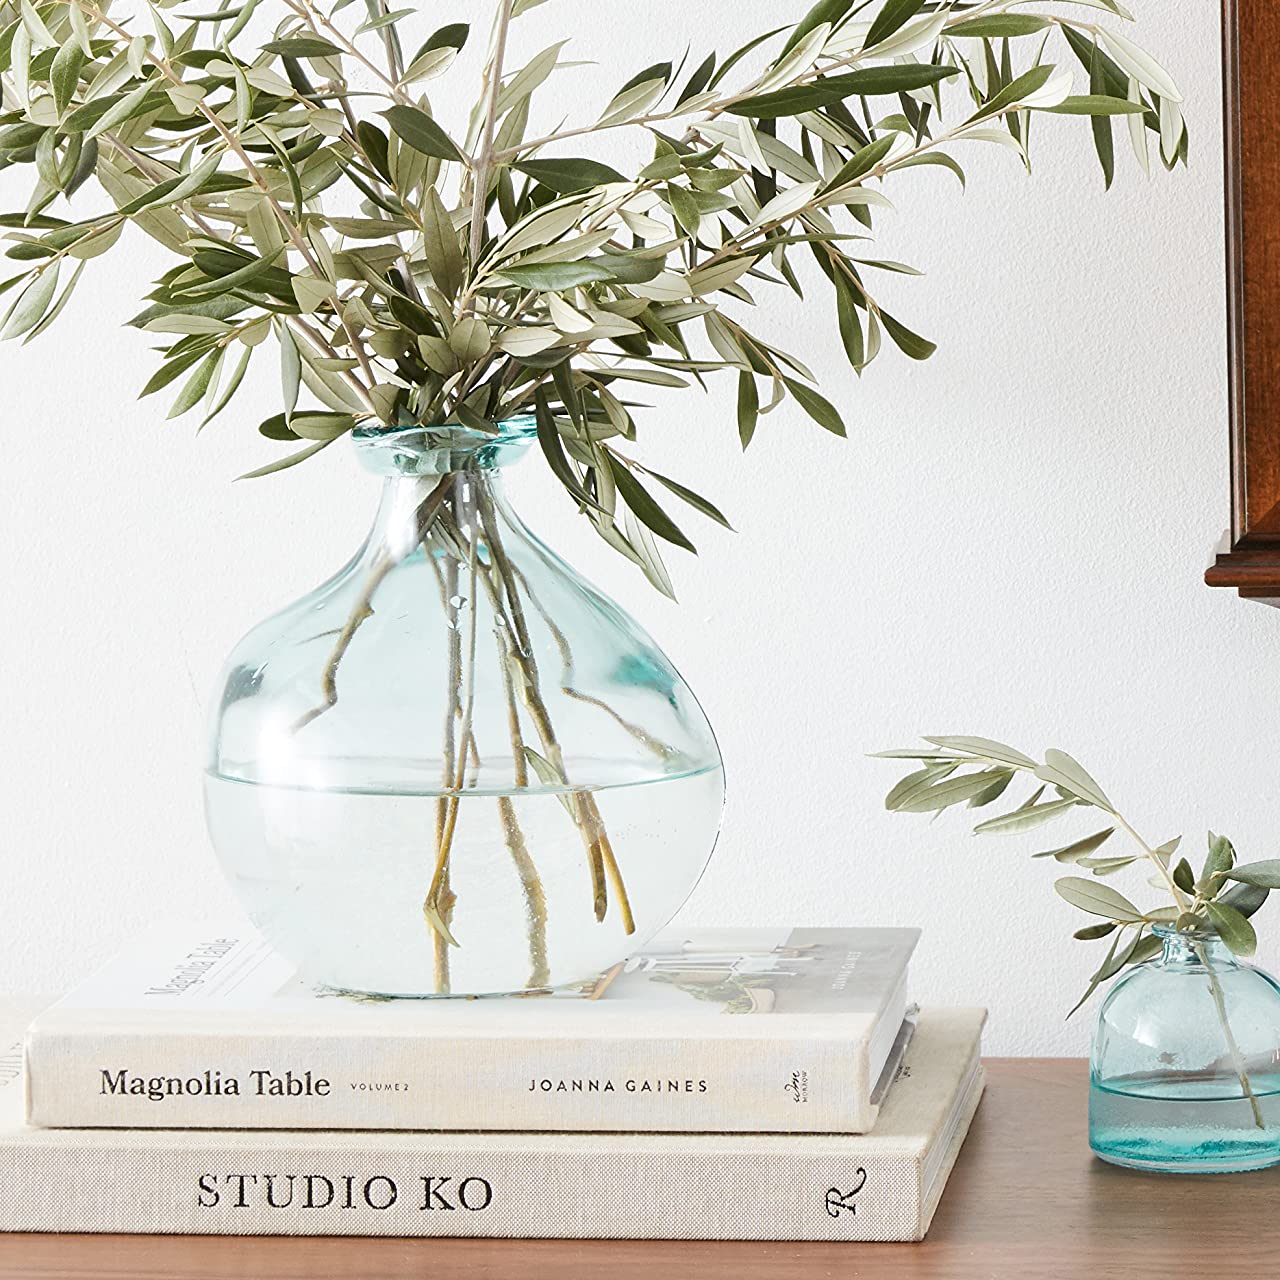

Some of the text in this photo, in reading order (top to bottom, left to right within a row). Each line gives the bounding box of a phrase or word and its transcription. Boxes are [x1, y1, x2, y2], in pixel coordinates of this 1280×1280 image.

[99, 1069, 410, 1101] Magnolia Table VOLUME 2
[528, 1079, 708, 1094] JOANNA GAINES
[198, 1173, 493, 1212] STUDIO KO
